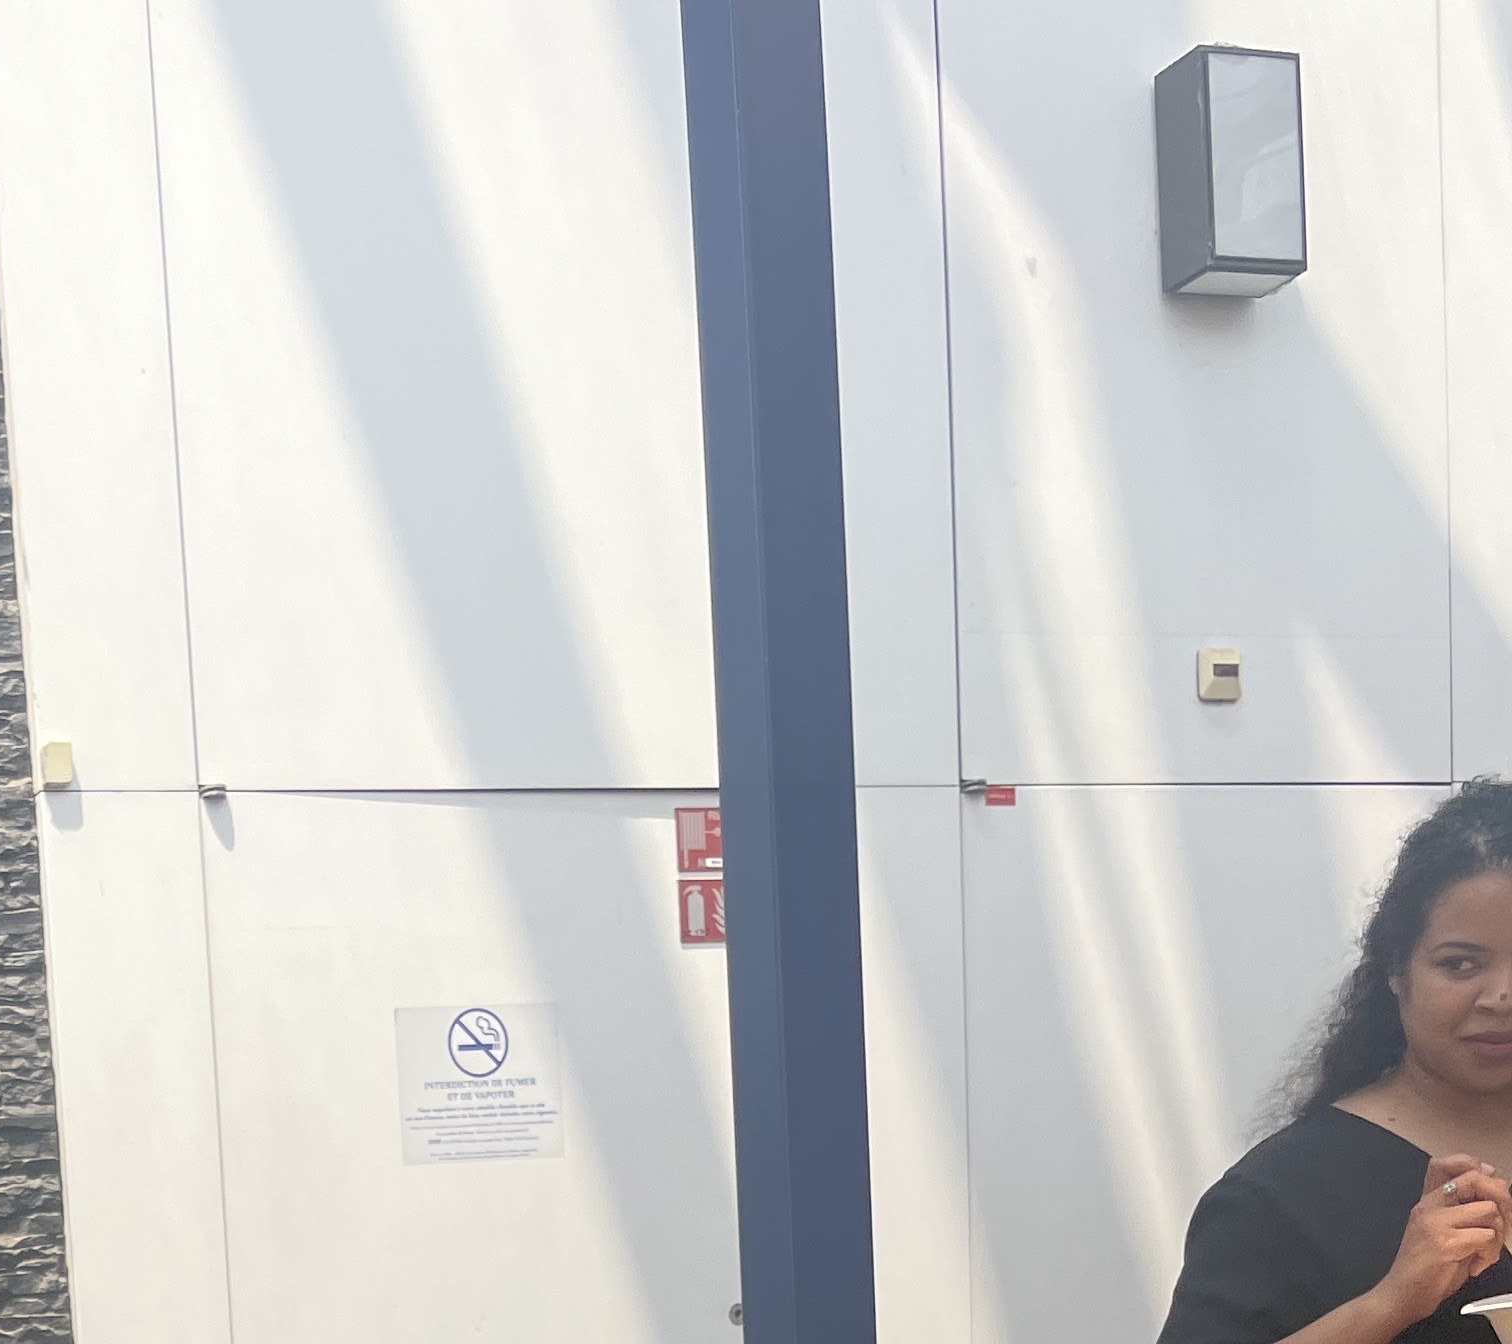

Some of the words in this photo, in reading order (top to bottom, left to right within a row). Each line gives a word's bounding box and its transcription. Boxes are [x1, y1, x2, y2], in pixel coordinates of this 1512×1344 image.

[424, 1079, 489, 1090] INTERDICTION
[491, 1079, 503, 1087] DE
[506, 1077, 536, 1087] FUMER
[447, 1092, 459, 1101] ET
[460, 1092, 473, 1101] DE
[474, 1090, 516, 1100] VAPOTER
